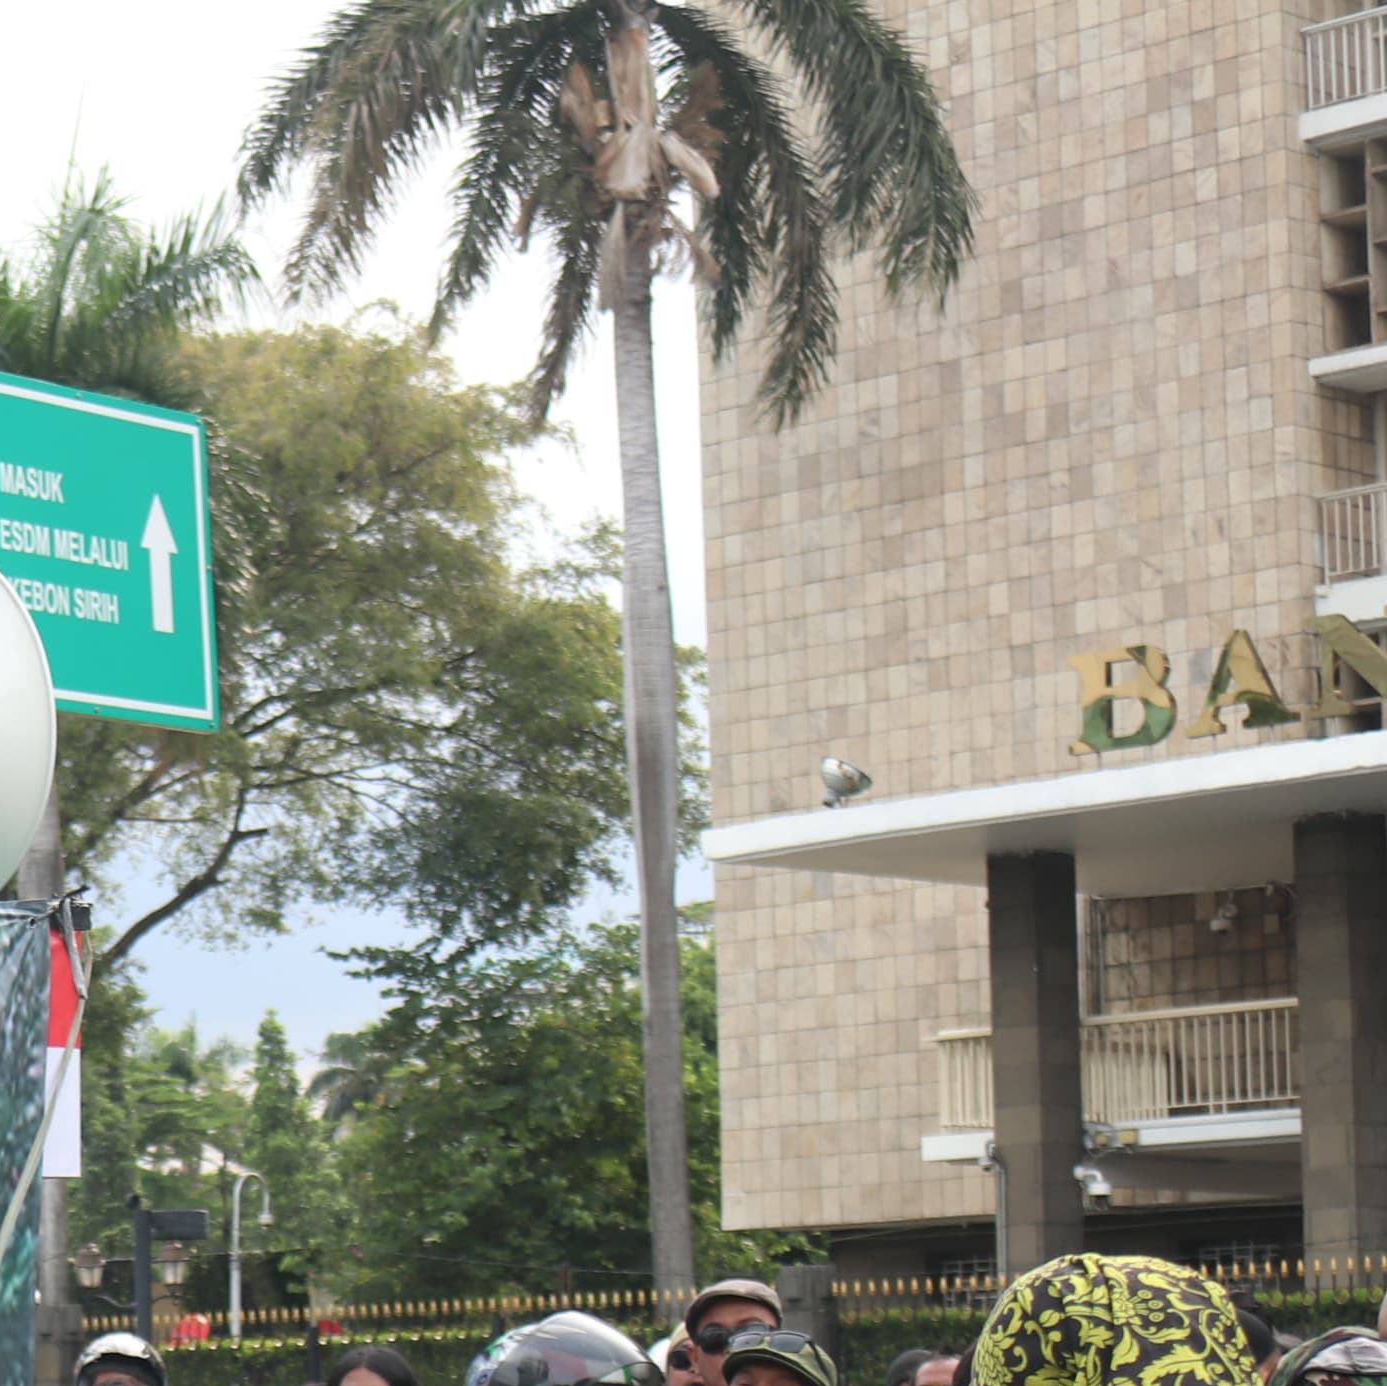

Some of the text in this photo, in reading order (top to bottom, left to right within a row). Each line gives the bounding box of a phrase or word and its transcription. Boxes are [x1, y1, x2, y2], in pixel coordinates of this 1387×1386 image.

[0, 461, 64, 503] MASUK
[0, 517, 50, 556] ESDM
[55, 528, 129, 571] MELALUI
[74, 587, 119, 624] SIRIH
